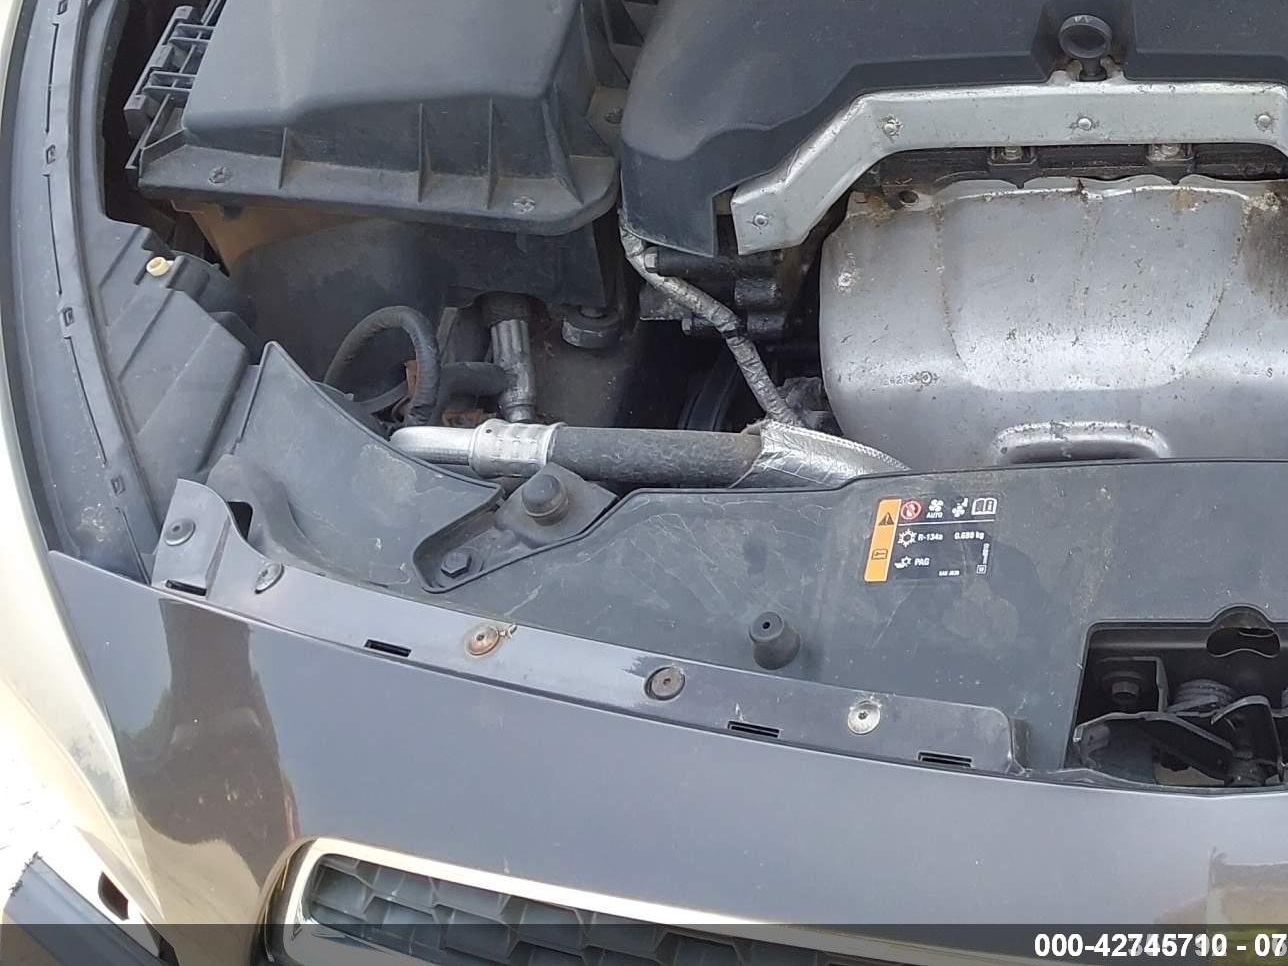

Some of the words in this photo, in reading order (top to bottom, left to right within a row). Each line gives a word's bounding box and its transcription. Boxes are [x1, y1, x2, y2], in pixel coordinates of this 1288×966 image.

[926, 511, 943, 519] AUTO
[917, 532, 944, 542] R-134a
[975, 529, 985, 541] kg
[914, 557, 930, 566] PAG
